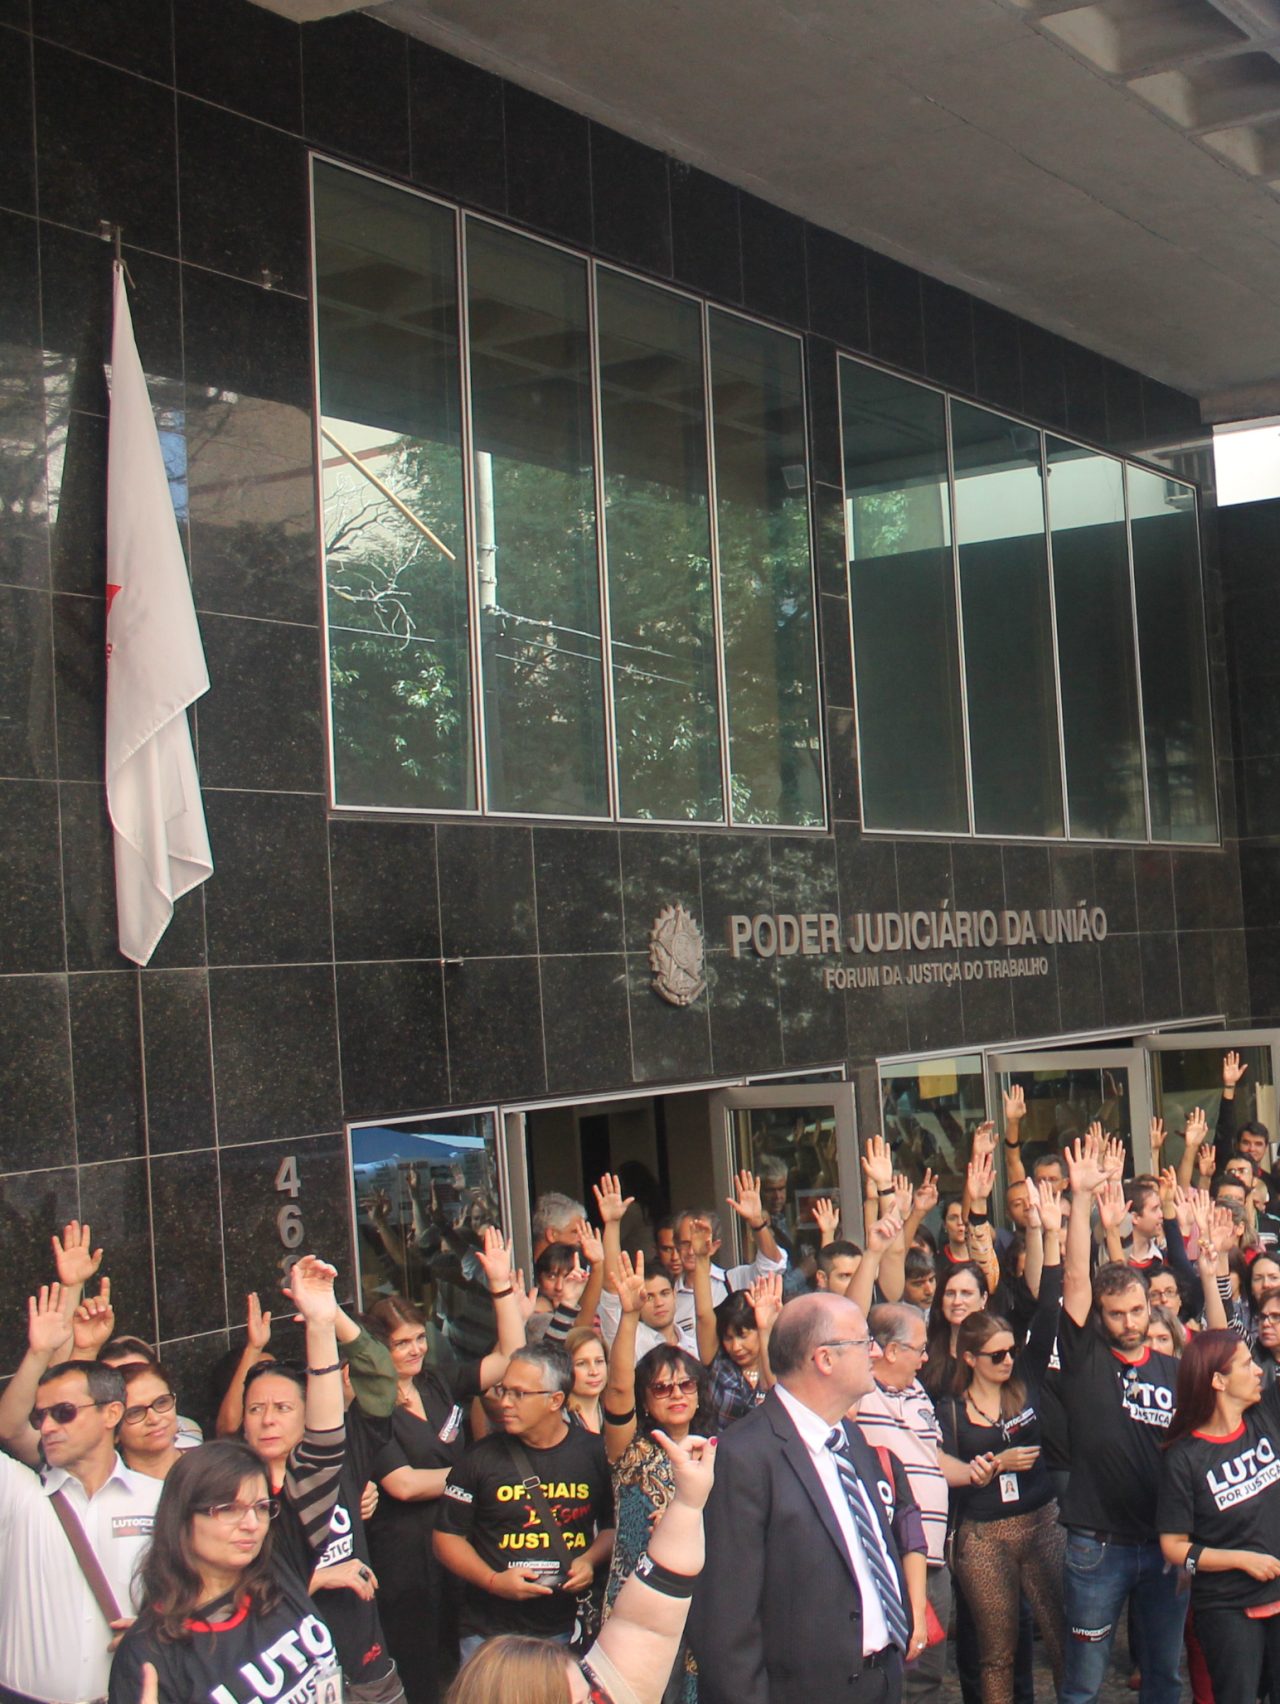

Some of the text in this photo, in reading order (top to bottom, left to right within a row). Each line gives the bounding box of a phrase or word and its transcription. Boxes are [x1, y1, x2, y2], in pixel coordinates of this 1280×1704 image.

[729, 899, 1108, 958] PODER JUDICIÁRIO DA UNIÃO
[824, 957, 1048, 990] FÓRUM DA JUSTIÇA DO TRABALHO
[1206, 1437, 1275, 1495] LUTO
[1218, 1488, 1243, 1507] POR
[113, 1518, 140, 1529] LUTO
[210, 1614, 336, 1704] LUTO
